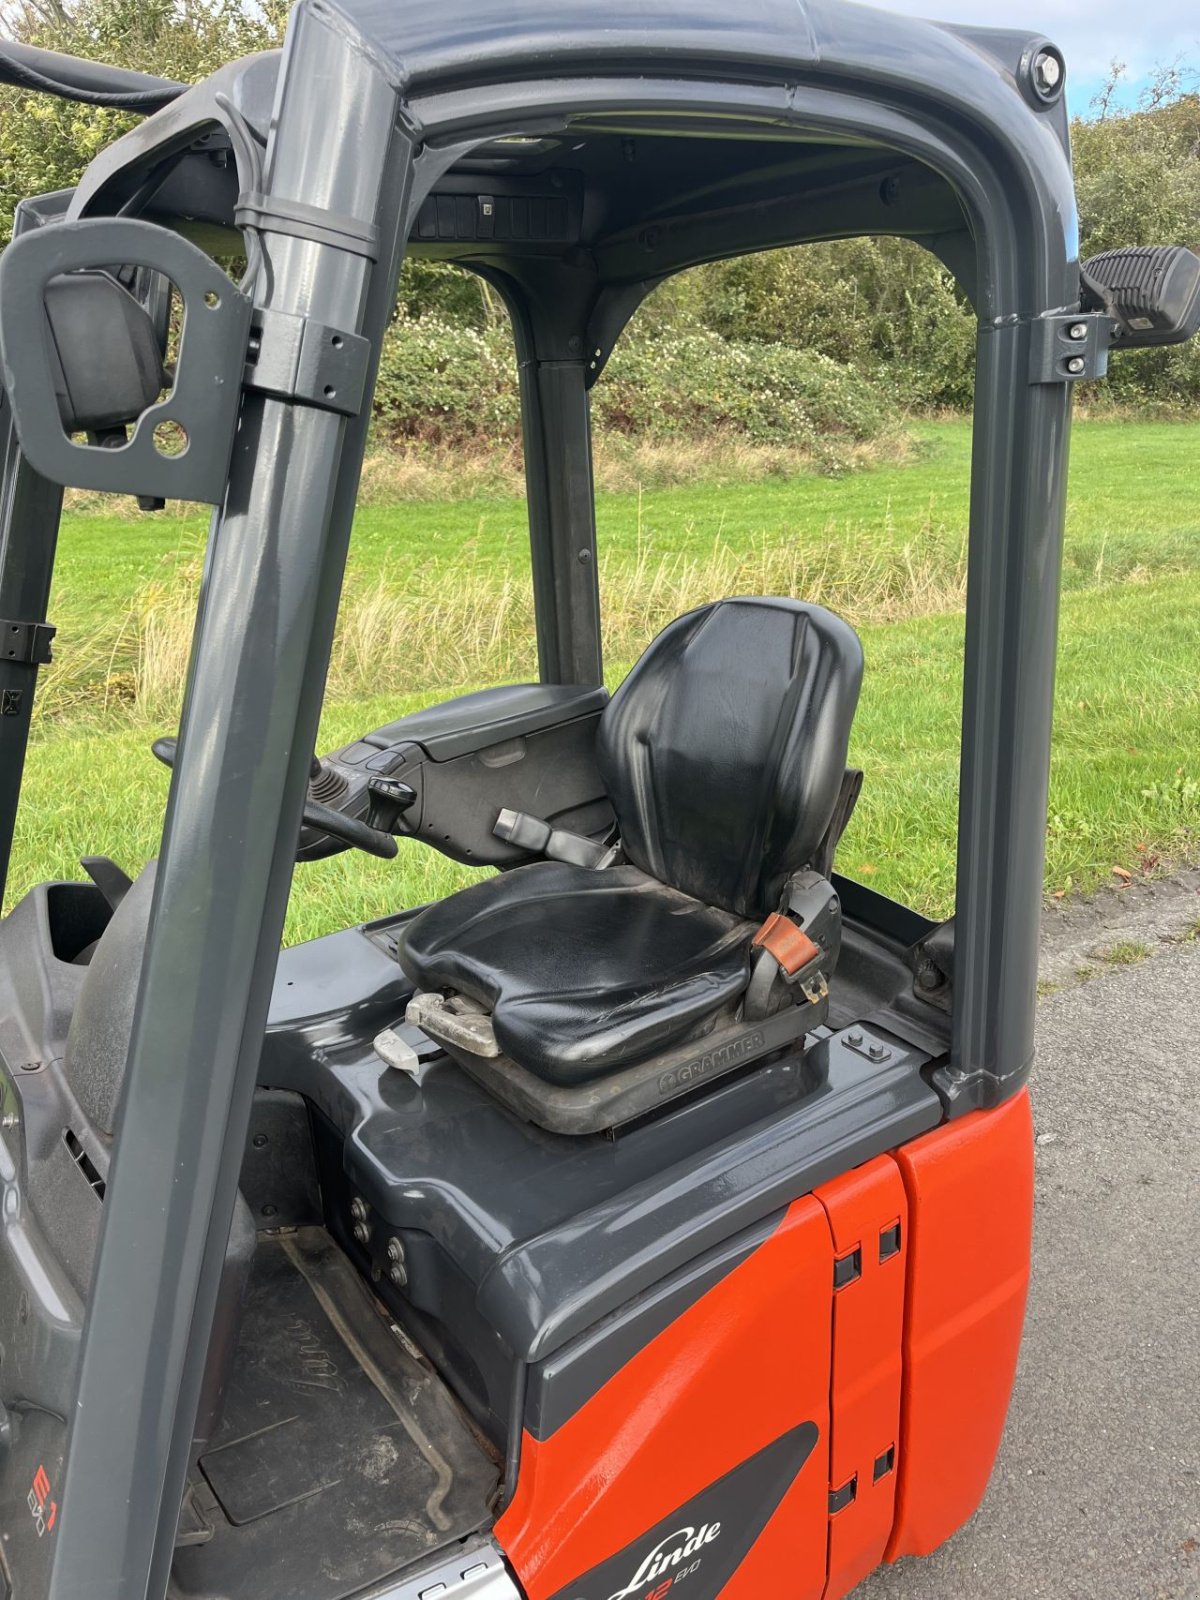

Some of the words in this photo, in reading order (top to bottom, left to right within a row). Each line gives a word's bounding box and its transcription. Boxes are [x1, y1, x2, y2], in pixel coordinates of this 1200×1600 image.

[678, 1032, 764, 1080] GRAMMER
[607, 1521, 721, 1600] Linde
[674, 1558, 702, 1584] EVO
